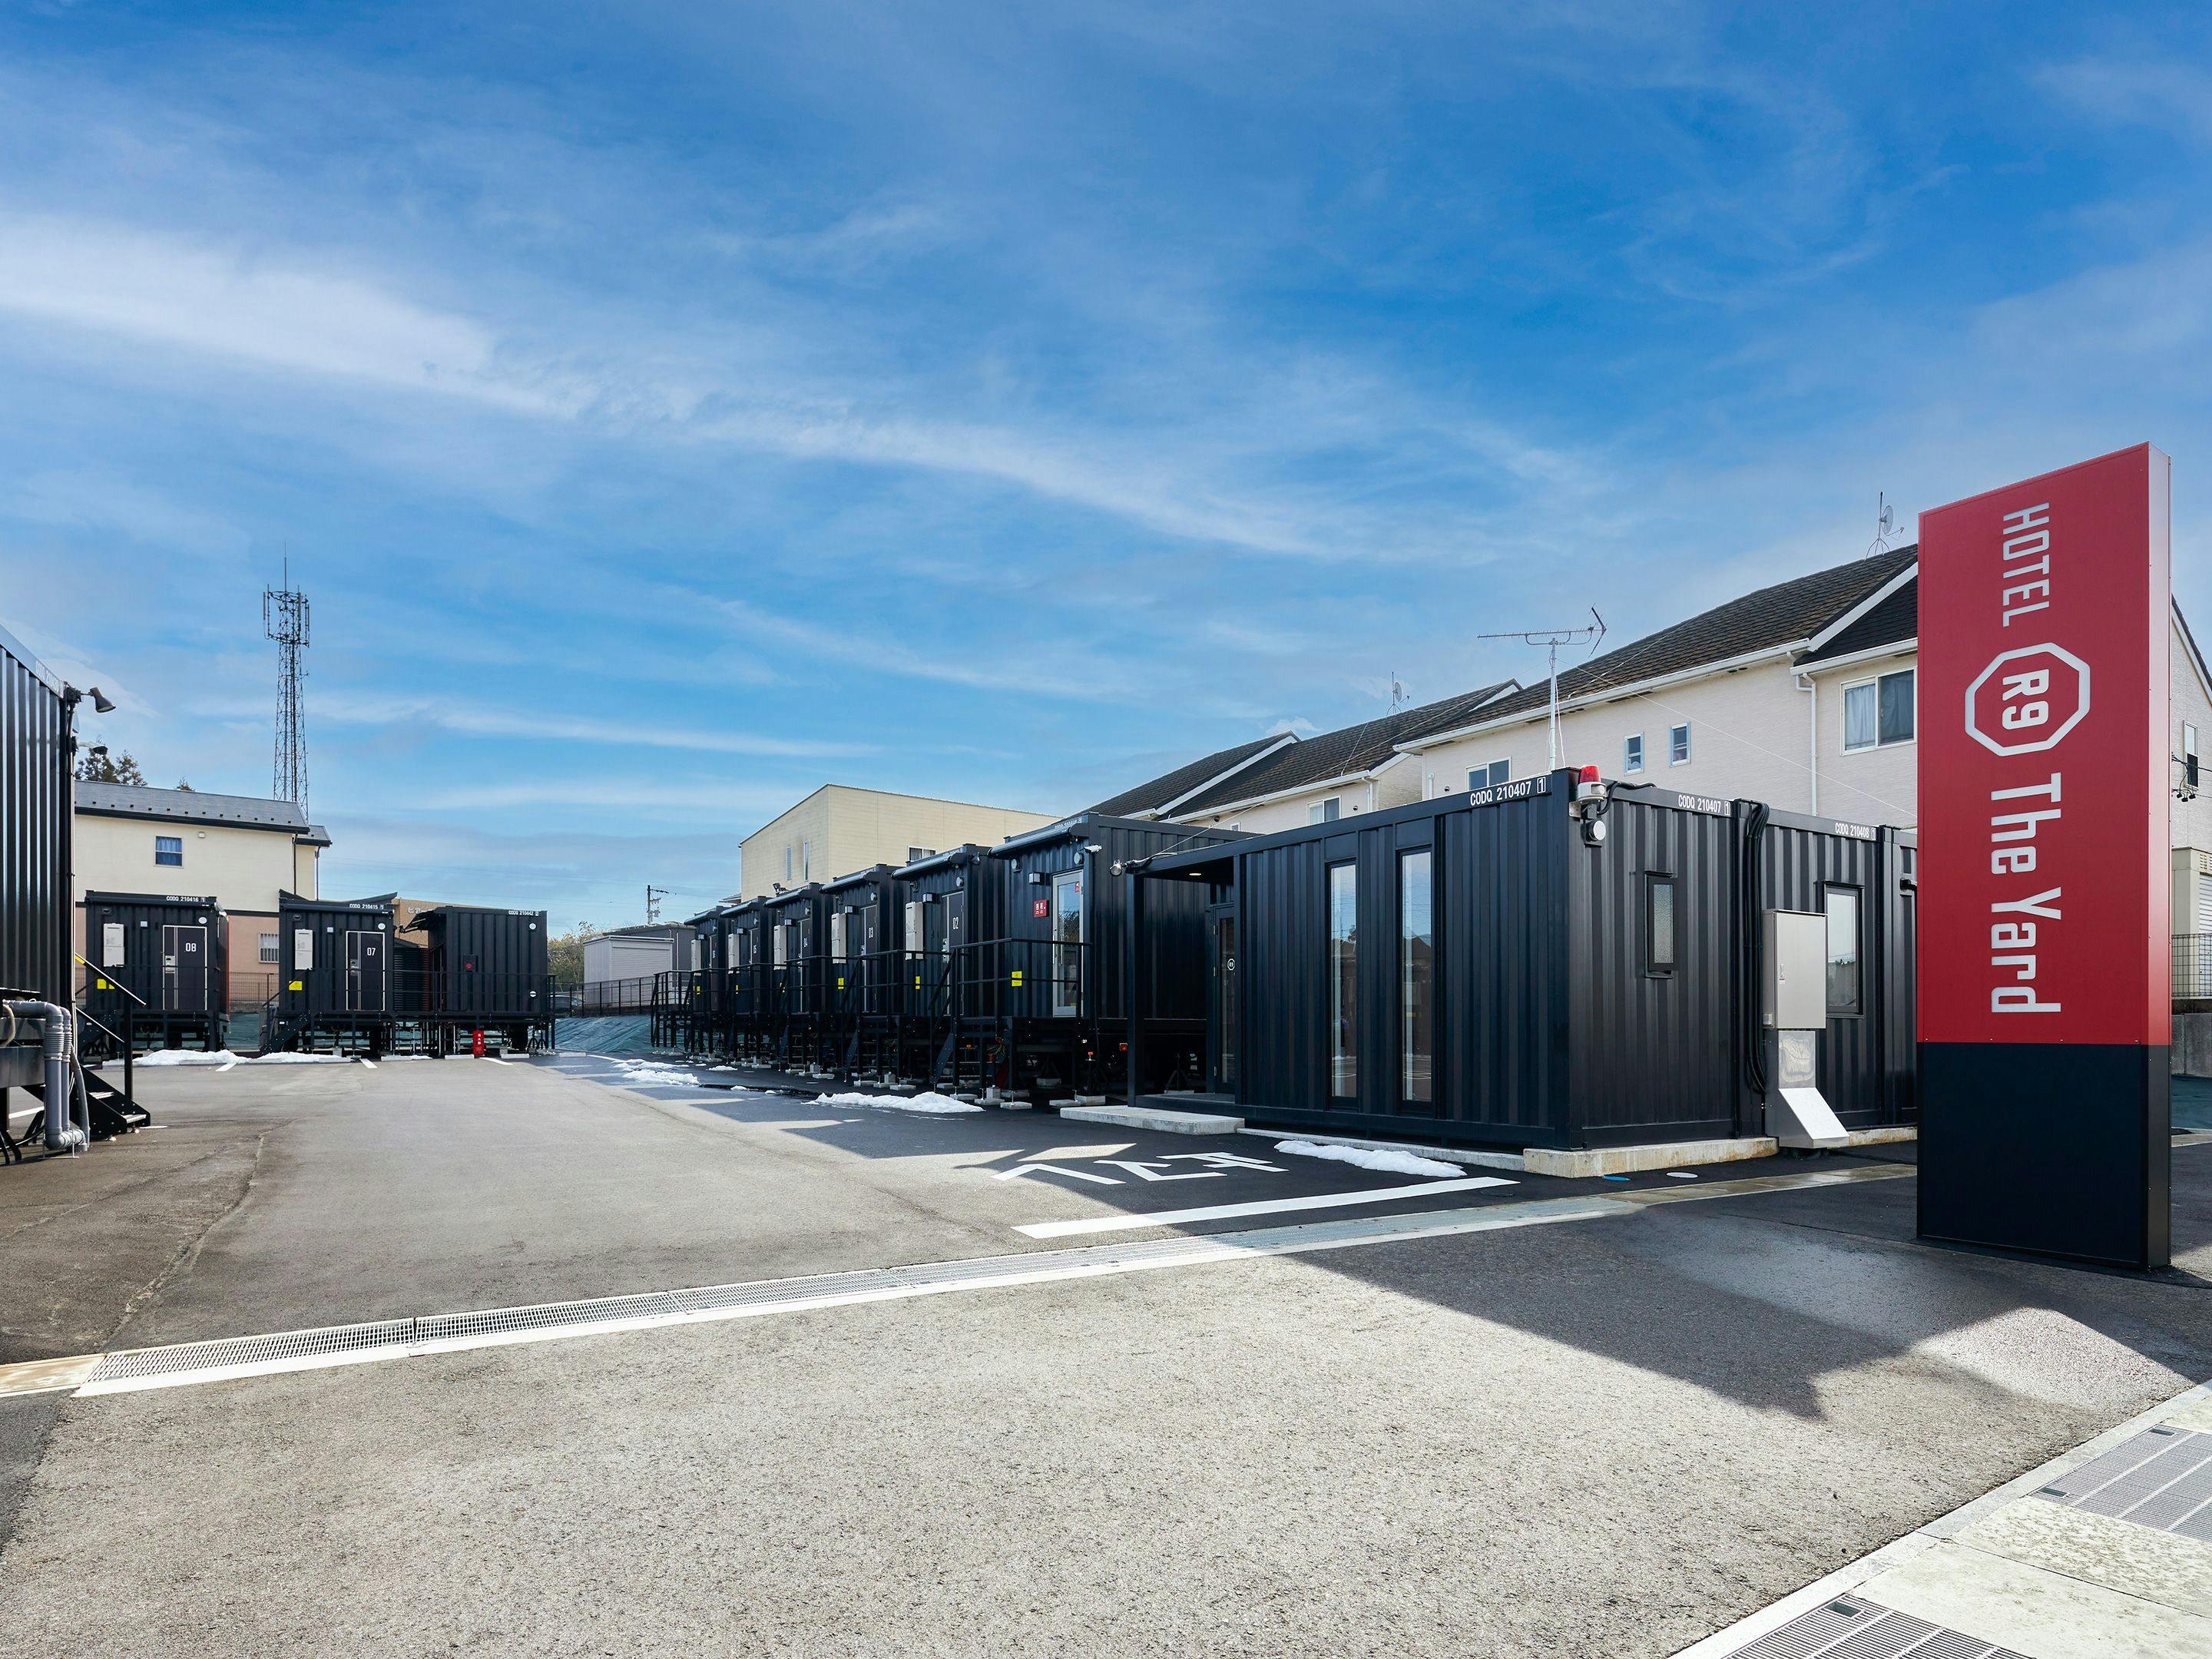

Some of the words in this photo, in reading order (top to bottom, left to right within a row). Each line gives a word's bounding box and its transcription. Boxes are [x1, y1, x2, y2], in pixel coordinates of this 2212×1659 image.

[2002, 502, 2050, 627] HOTEL
[2002, 668, 2049, 730] R9
[1470, 790, 1493, 806] CODQ
[1496, 780, 1532, 801] 210407
[1677, 794, 1695, 810] CODQ
[1697, 796, 1721, 814] 210407
[1835, 822, 1849, 835] CODQ
[1850, 824, 1869, 839] 210408
[1991, 772, 2061, 875] The
[952, 916, 959, 930] 02
[185, 942, 197, 952] 08
[366, 947, 376, 956] 07
[1991, 886, 2061, 1013] Yard
